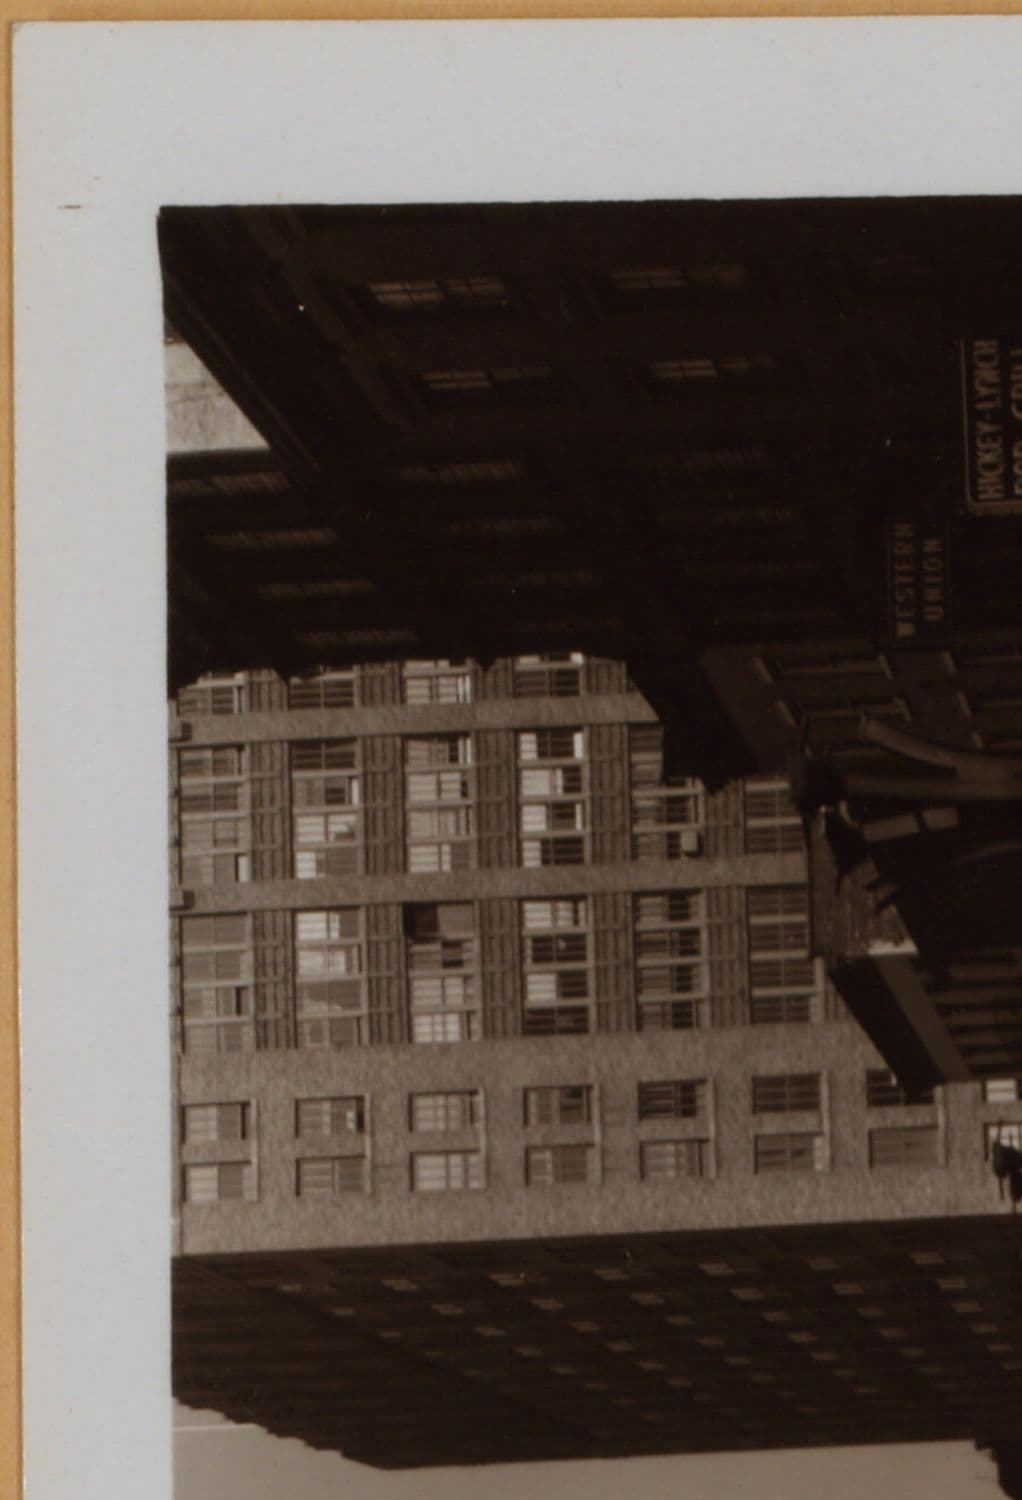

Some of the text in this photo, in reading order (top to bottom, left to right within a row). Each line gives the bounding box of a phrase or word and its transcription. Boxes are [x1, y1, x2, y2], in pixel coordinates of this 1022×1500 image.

[973, 339, 1005, 500] HICKEY-LYNCH
[893, 522, 916, 640] WESTERN
[922, 538, 944, 621] UNION
